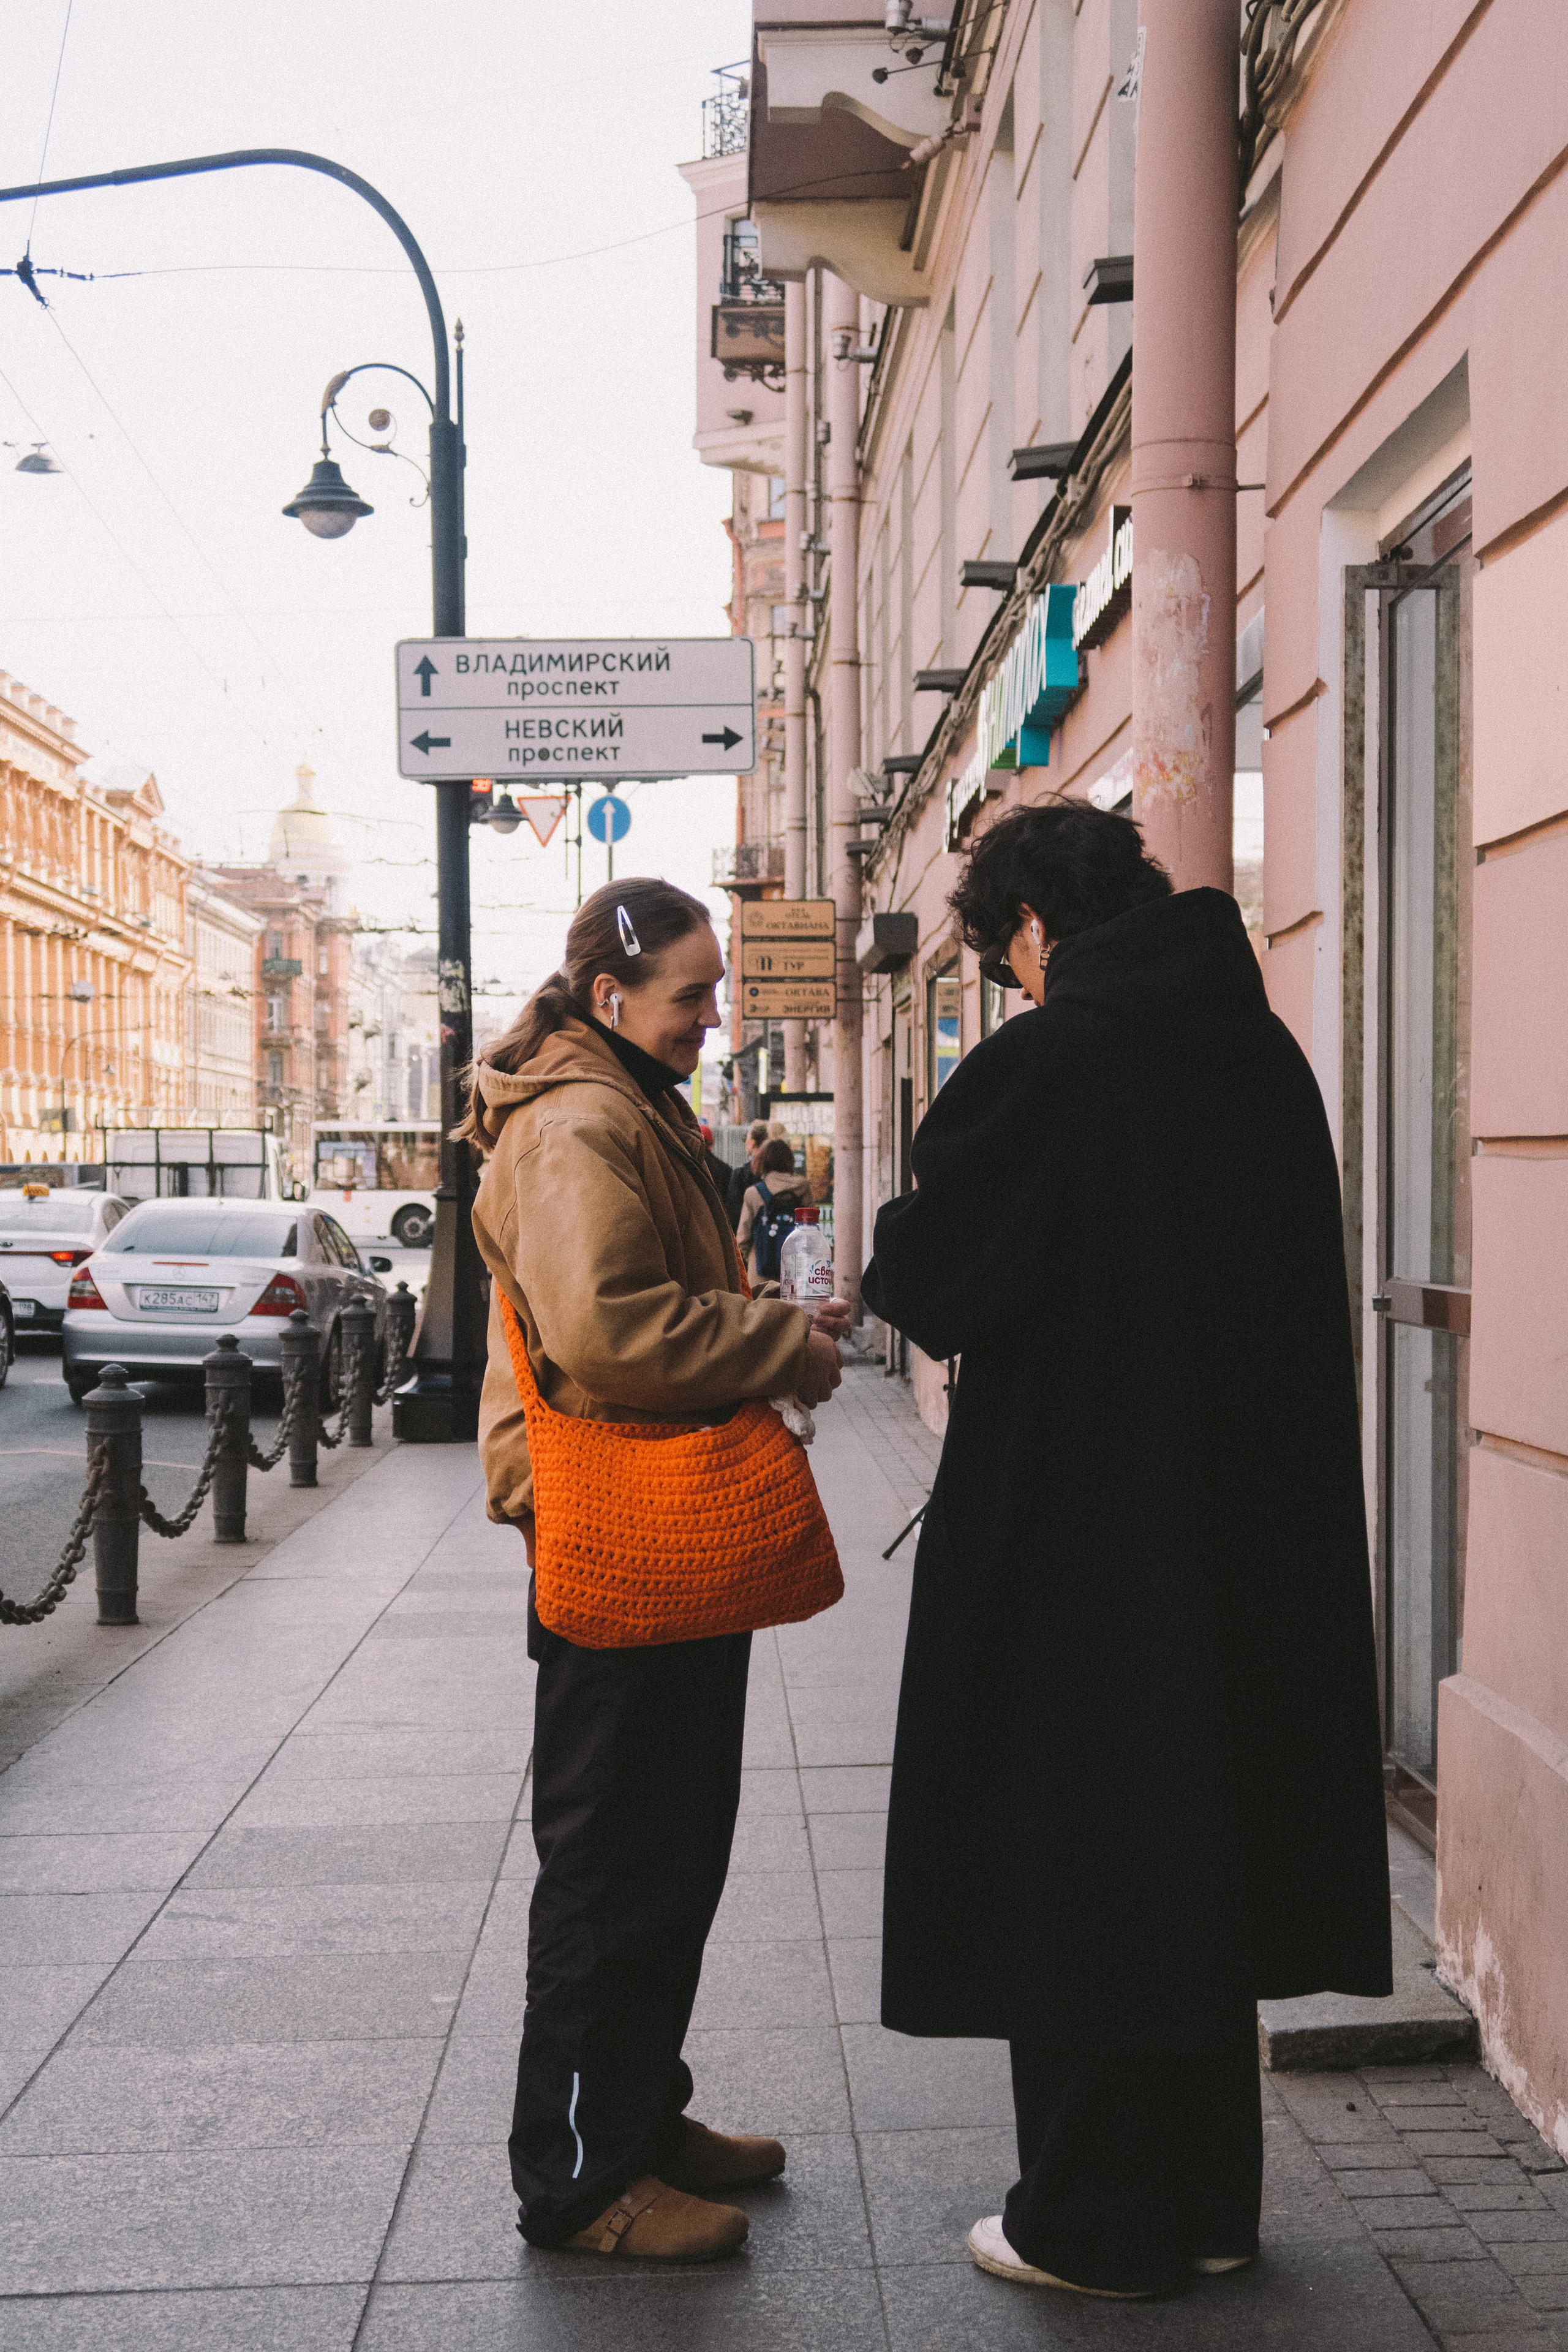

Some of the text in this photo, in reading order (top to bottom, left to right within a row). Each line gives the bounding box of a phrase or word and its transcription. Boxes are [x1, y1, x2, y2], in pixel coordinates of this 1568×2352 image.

[456, 646, 670, 676] ВЛАДИМИРСКИЙ
[507, 680, 619, 701] проспект
[505, 712, 623, 739] НЕВСКИЙ
[508, 746, 620, 767] проспект
